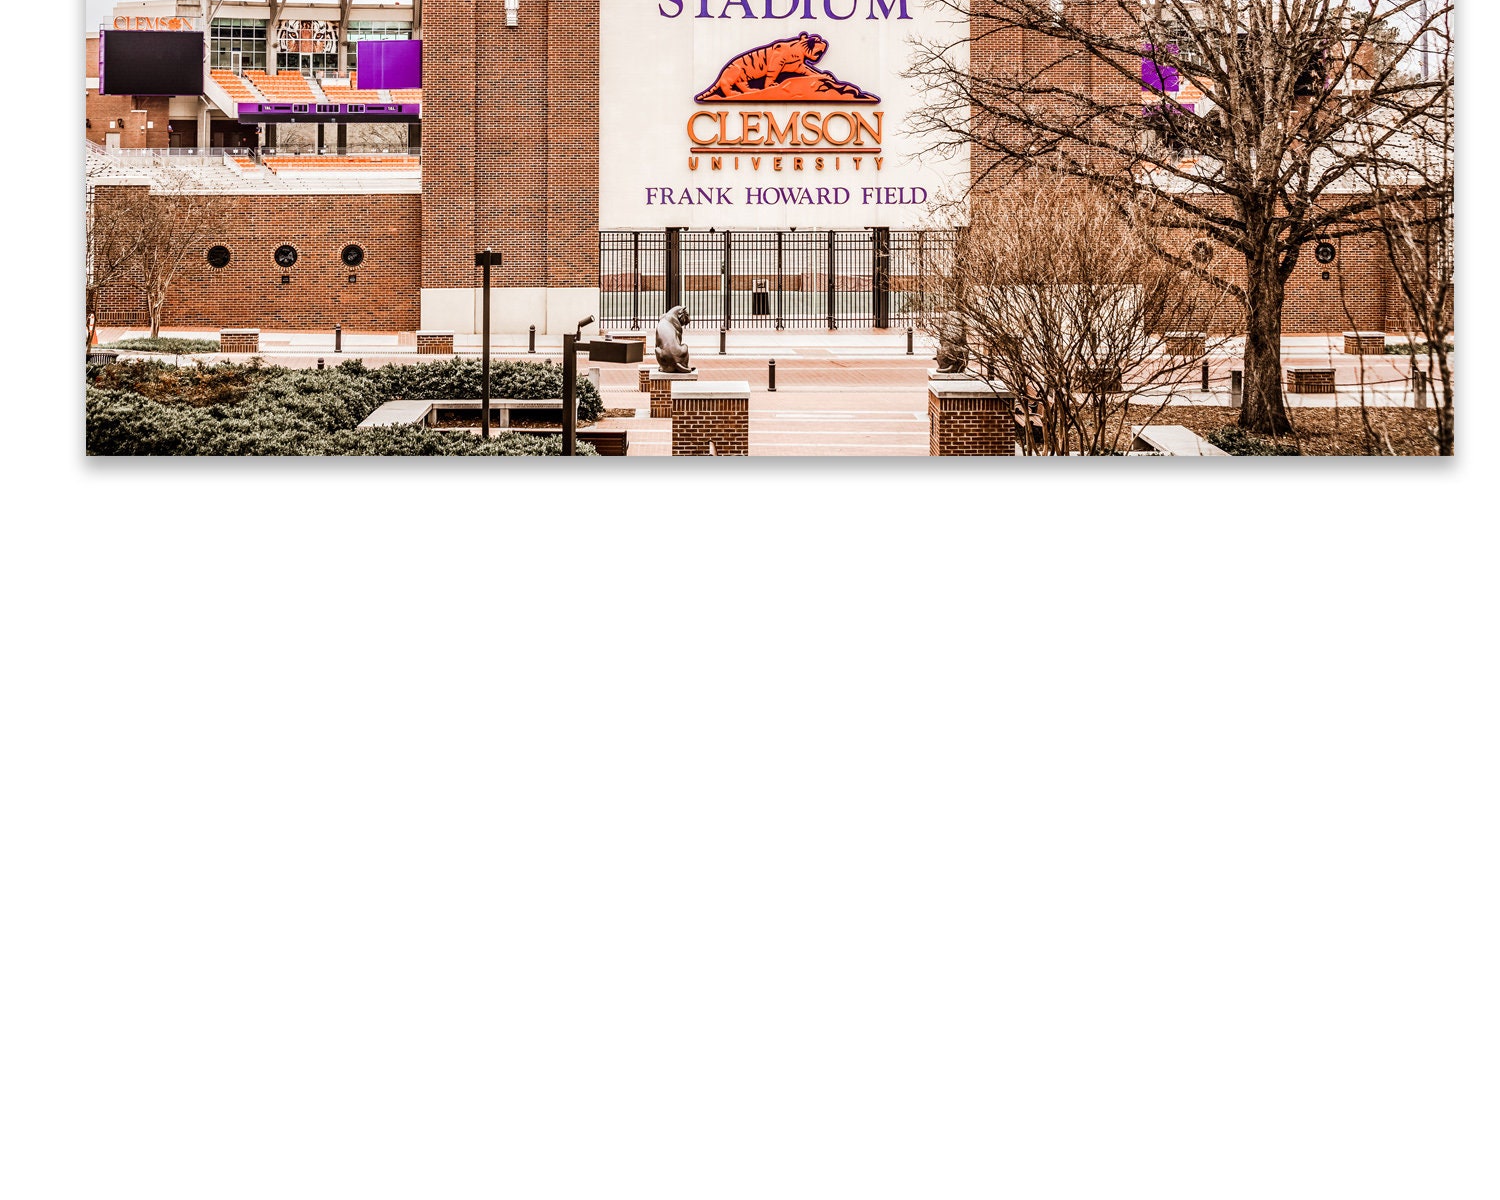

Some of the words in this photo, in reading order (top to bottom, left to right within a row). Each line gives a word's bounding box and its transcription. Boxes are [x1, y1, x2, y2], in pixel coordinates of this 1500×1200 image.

[687, 111, 884, 146] CLEMSON
[688, 157, 884, 171] UNIVERSITY
[645, 187, 733, 205] FRANK
[746, 187, 850, 205] HOWARD
[862, 187, 928, 205] FIELD
